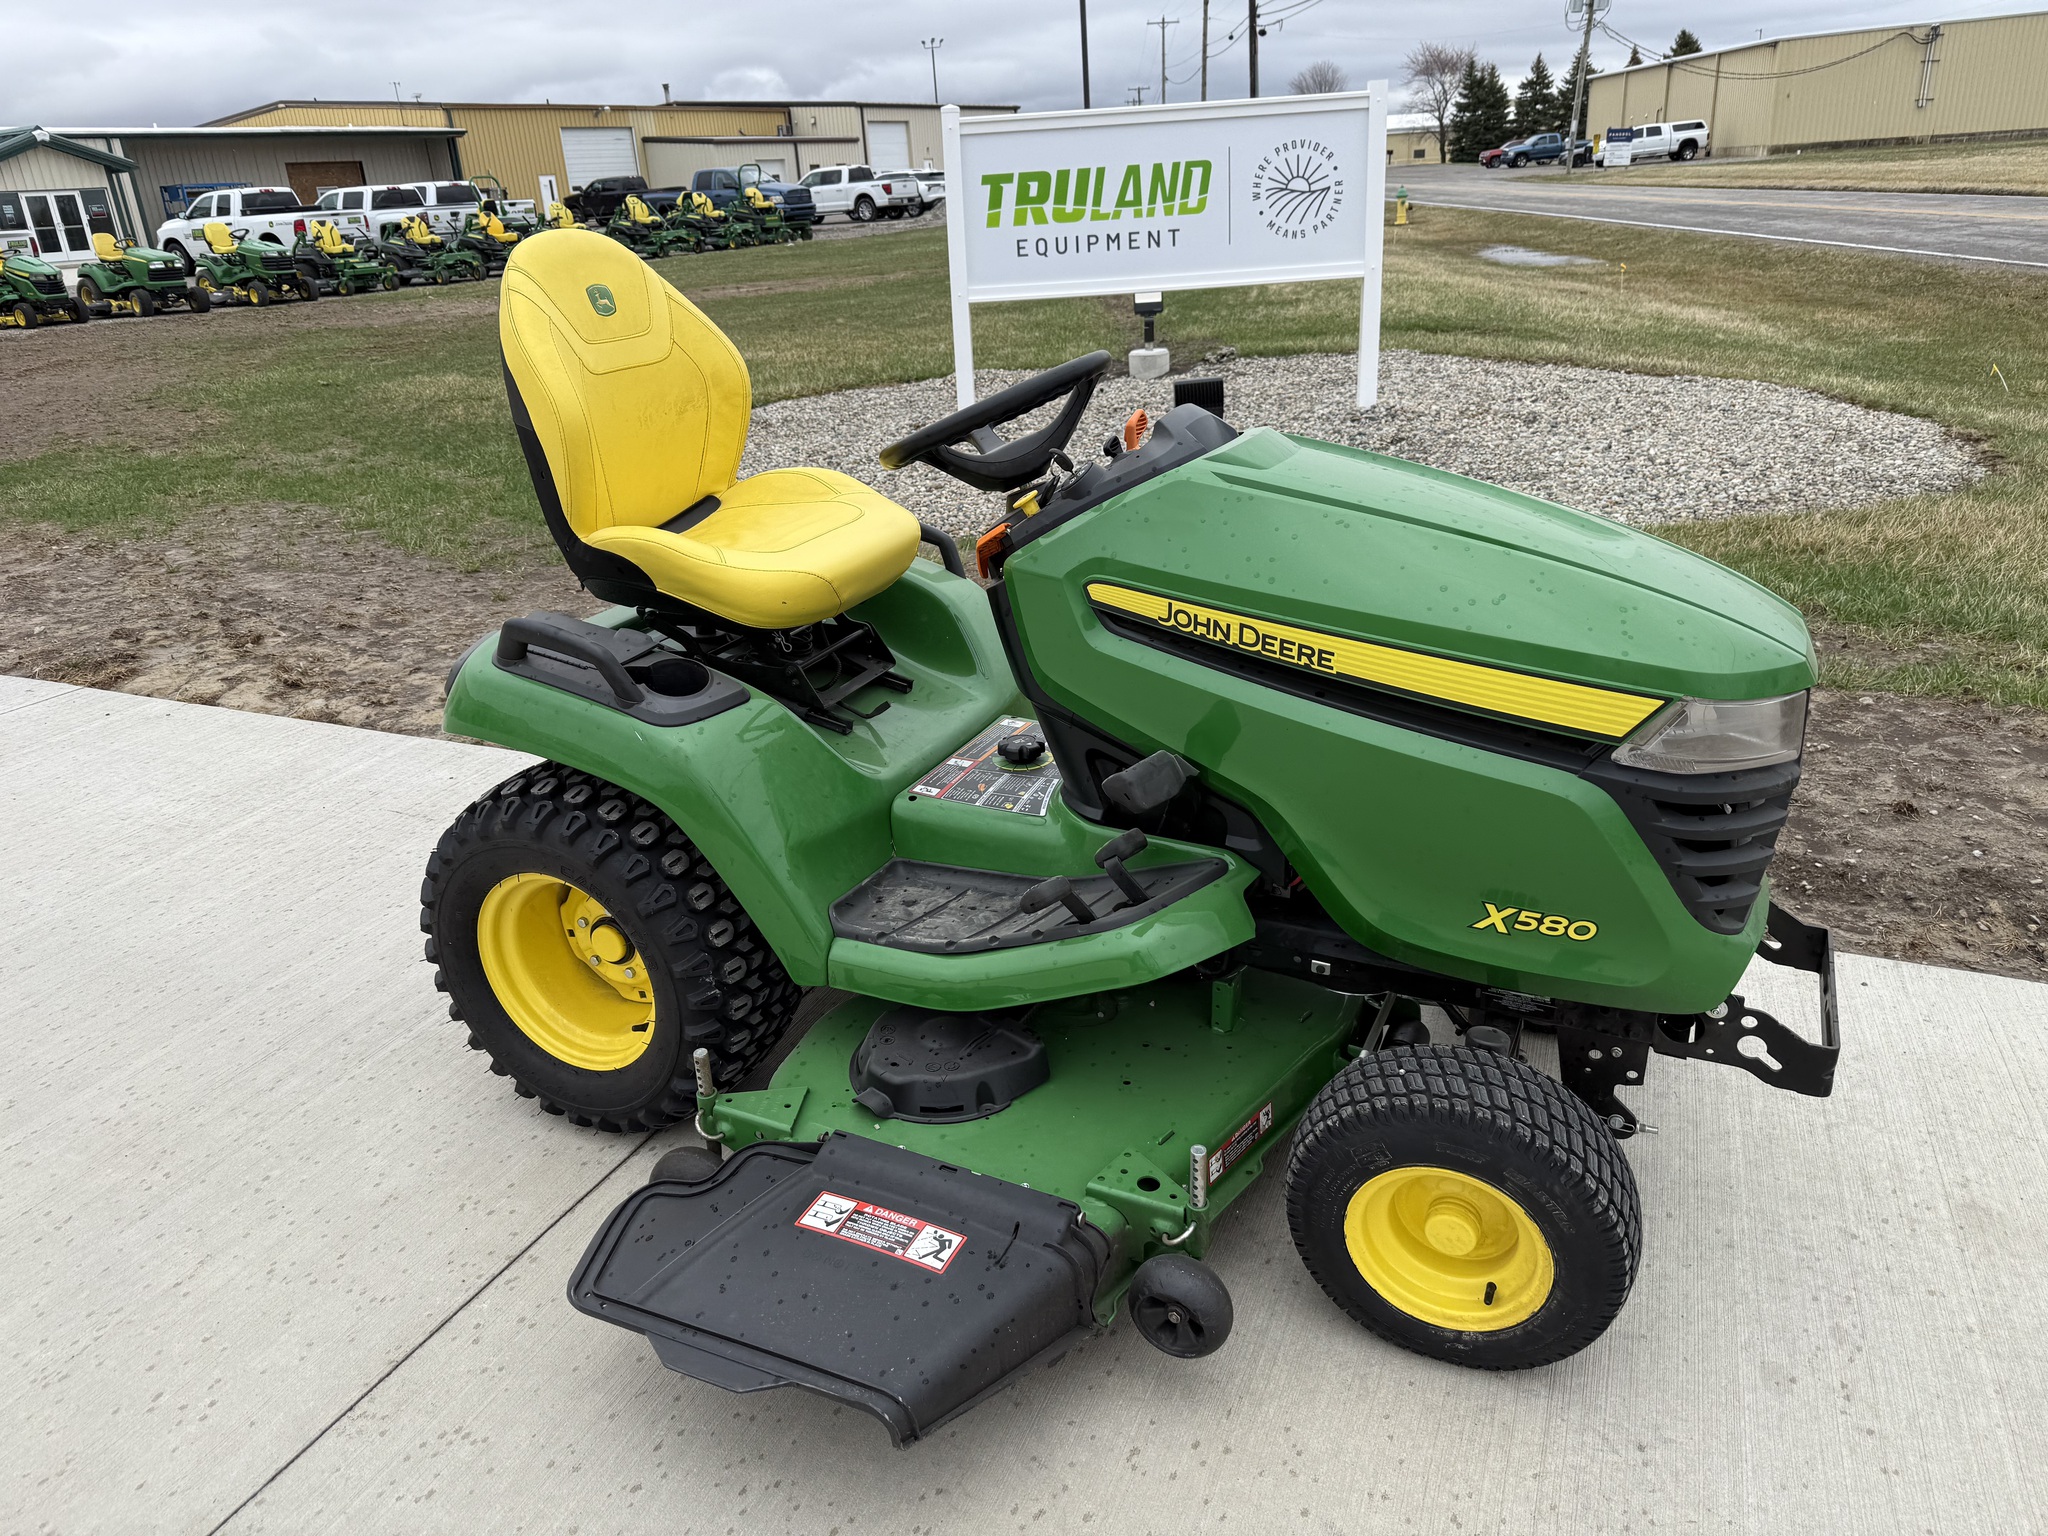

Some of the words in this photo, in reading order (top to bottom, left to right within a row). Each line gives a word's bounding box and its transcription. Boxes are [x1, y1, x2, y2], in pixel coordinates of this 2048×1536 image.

[981, 160, 1212, 228] TRULAND
[1252, 156, 1272, 201] WHERE
[1274, 139, 1334, 161] PROVIDER
[1266, 219, 1306, 239] MEANS
[1312, 179, 1344, 234] PARTNER
[1016, 229, 1180, 258] EQUIPMENT
[1158, 601, 1231, 642] JOHN
[1238, 622, 1336, 671] DEERE
[1469, 901, 1598, 941] X580
[874, 1208, 918, 1227] DANGER
